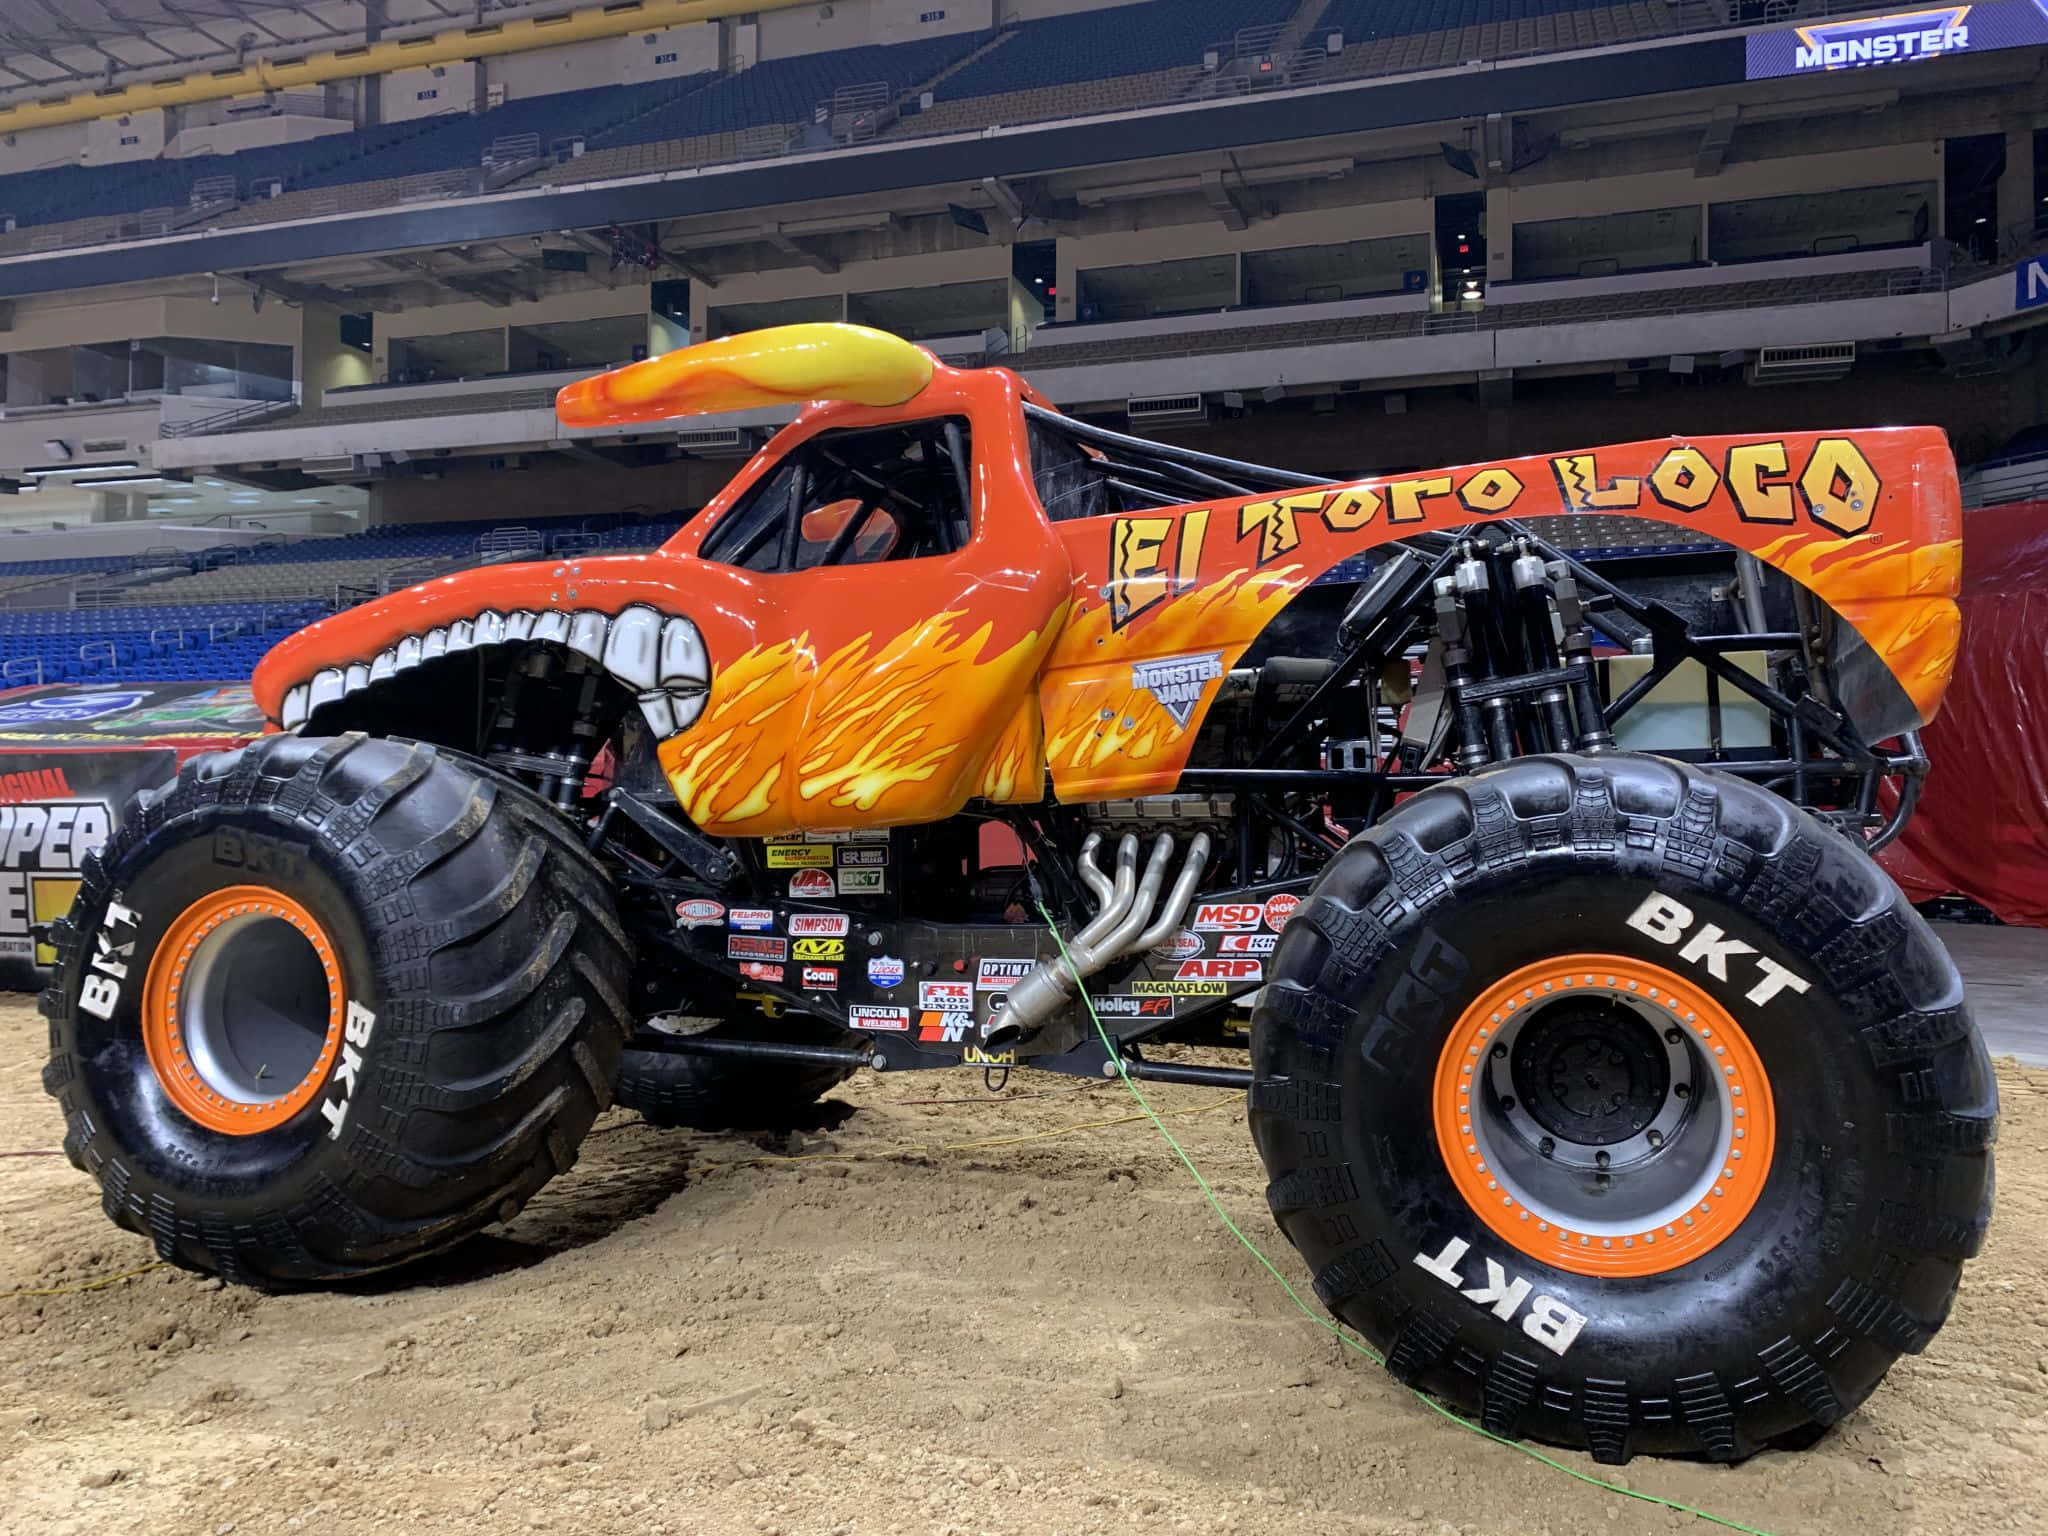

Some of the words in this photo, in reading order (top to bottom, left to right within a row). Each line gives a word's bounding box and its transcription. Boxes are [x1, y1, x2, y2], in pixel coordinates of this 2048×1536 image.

[1796, 26, 1969, 68] MONSTER
[1132, 660, 1223, 689] MONSTER
[1153, 682, 1202, 705] JAM
[772, 848, 811, 857] ENERGY
[842, 871, 881, 886] BKT
[1198, 905, 1260, 922] MSD
[1269, 903, 1296, 912] NGK
[794, 918, 844, 931] SIMPSON
[1625, 890, 1813, 1007] BKT
[79, 900, 142, 1020] BKT
[1178, 960, 1260, 976] ARP
[803, 968, 834, 981] Coan
[983, 963, 1030, 976] OPTIMA
[927, 985, 969, 996] FK
[1133, 983, 1225, 993] MAGNAFLOW
[852, 1007, 898, 1018] LINCOLN
[1094, 997, 1140, 1016] Holley
[862, 1020, 904, 1028] WELDERS
[964, 1046, 1015, 1064] UNOH
[320, 999, 376, 1141] BKT
[1413, 1236, 1588, 1356] BKT
